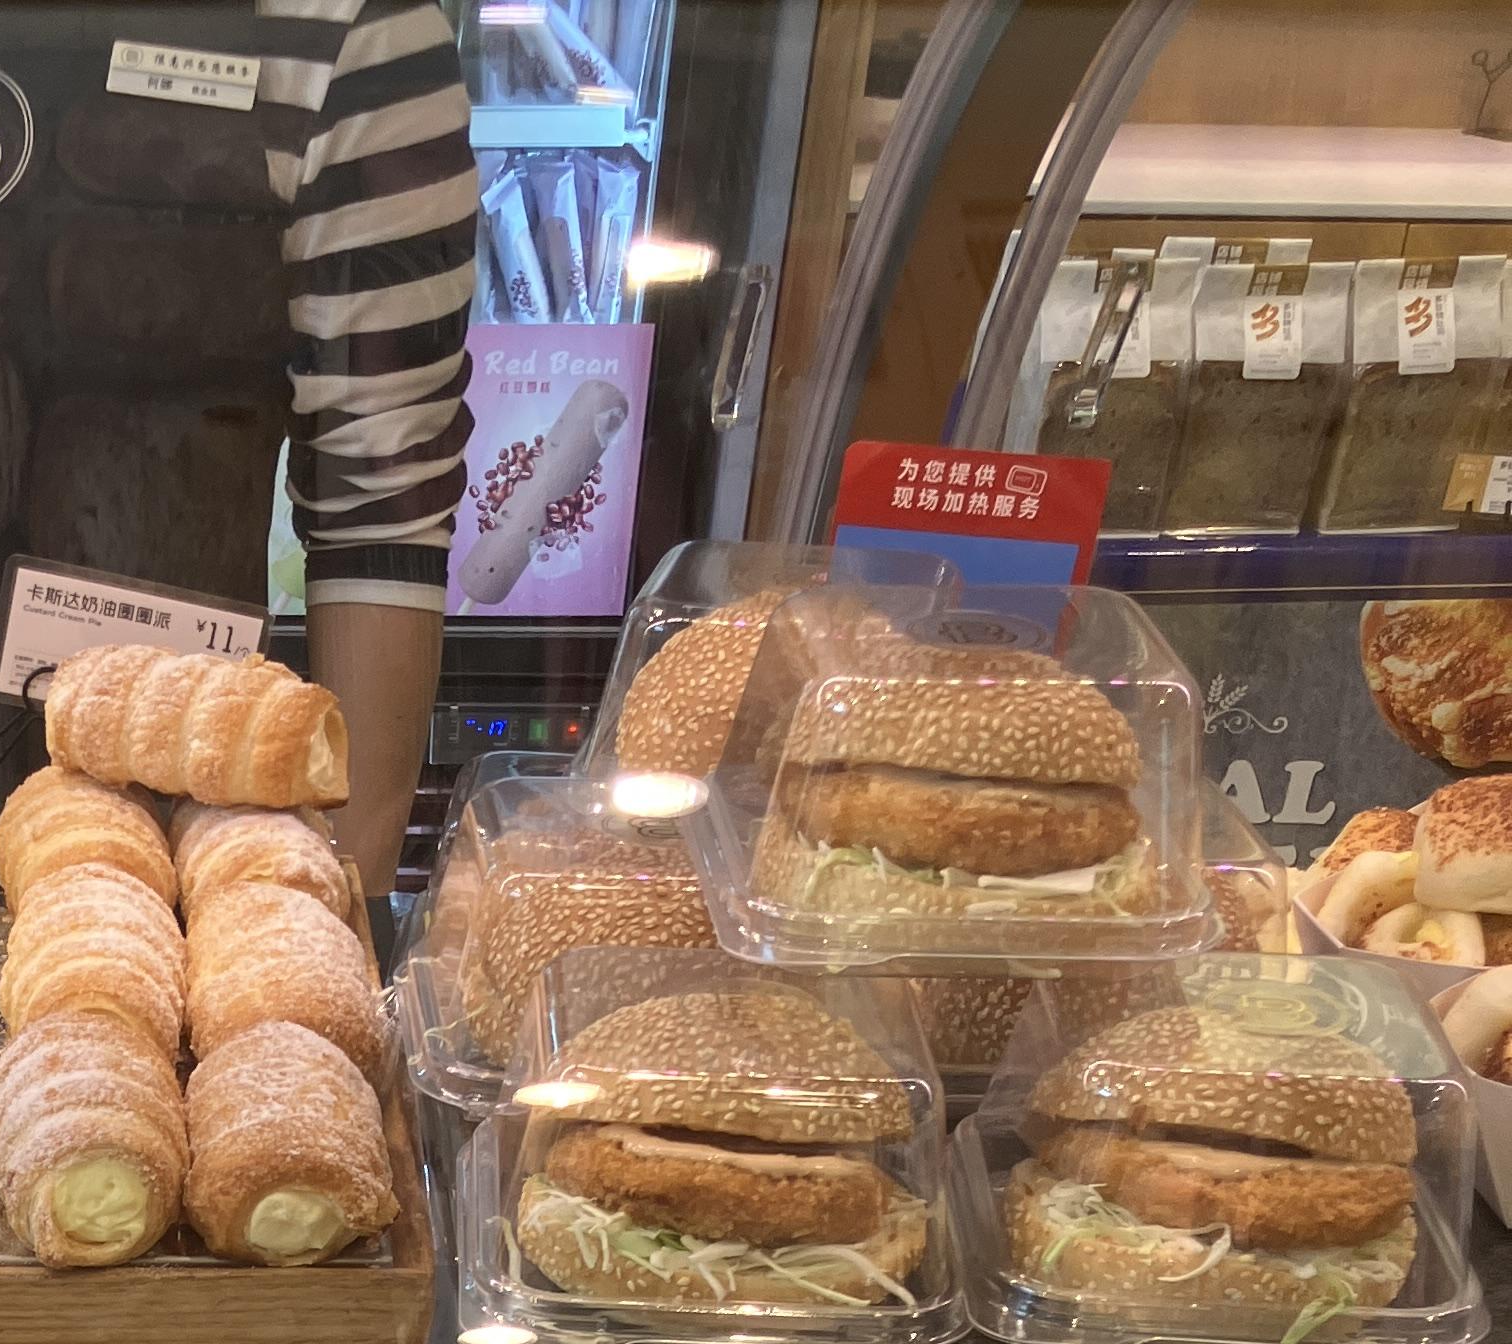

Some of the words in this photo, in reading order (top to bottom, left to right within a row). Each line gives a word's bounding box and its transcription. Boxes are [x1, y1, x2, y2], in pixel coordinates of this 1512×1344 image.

[483, 349, 537, 376] Red
[549, 350, 620, 376] Bean
[897, 457, 996, 488] 为您提供
[891, 487, 1040, 520] 现场加热服务
[23, 604, 56, 617] Custard
[58, 611, 87, 624] Cream
[26, 584, 172, 631] 卡斯达奶油圈圈派
